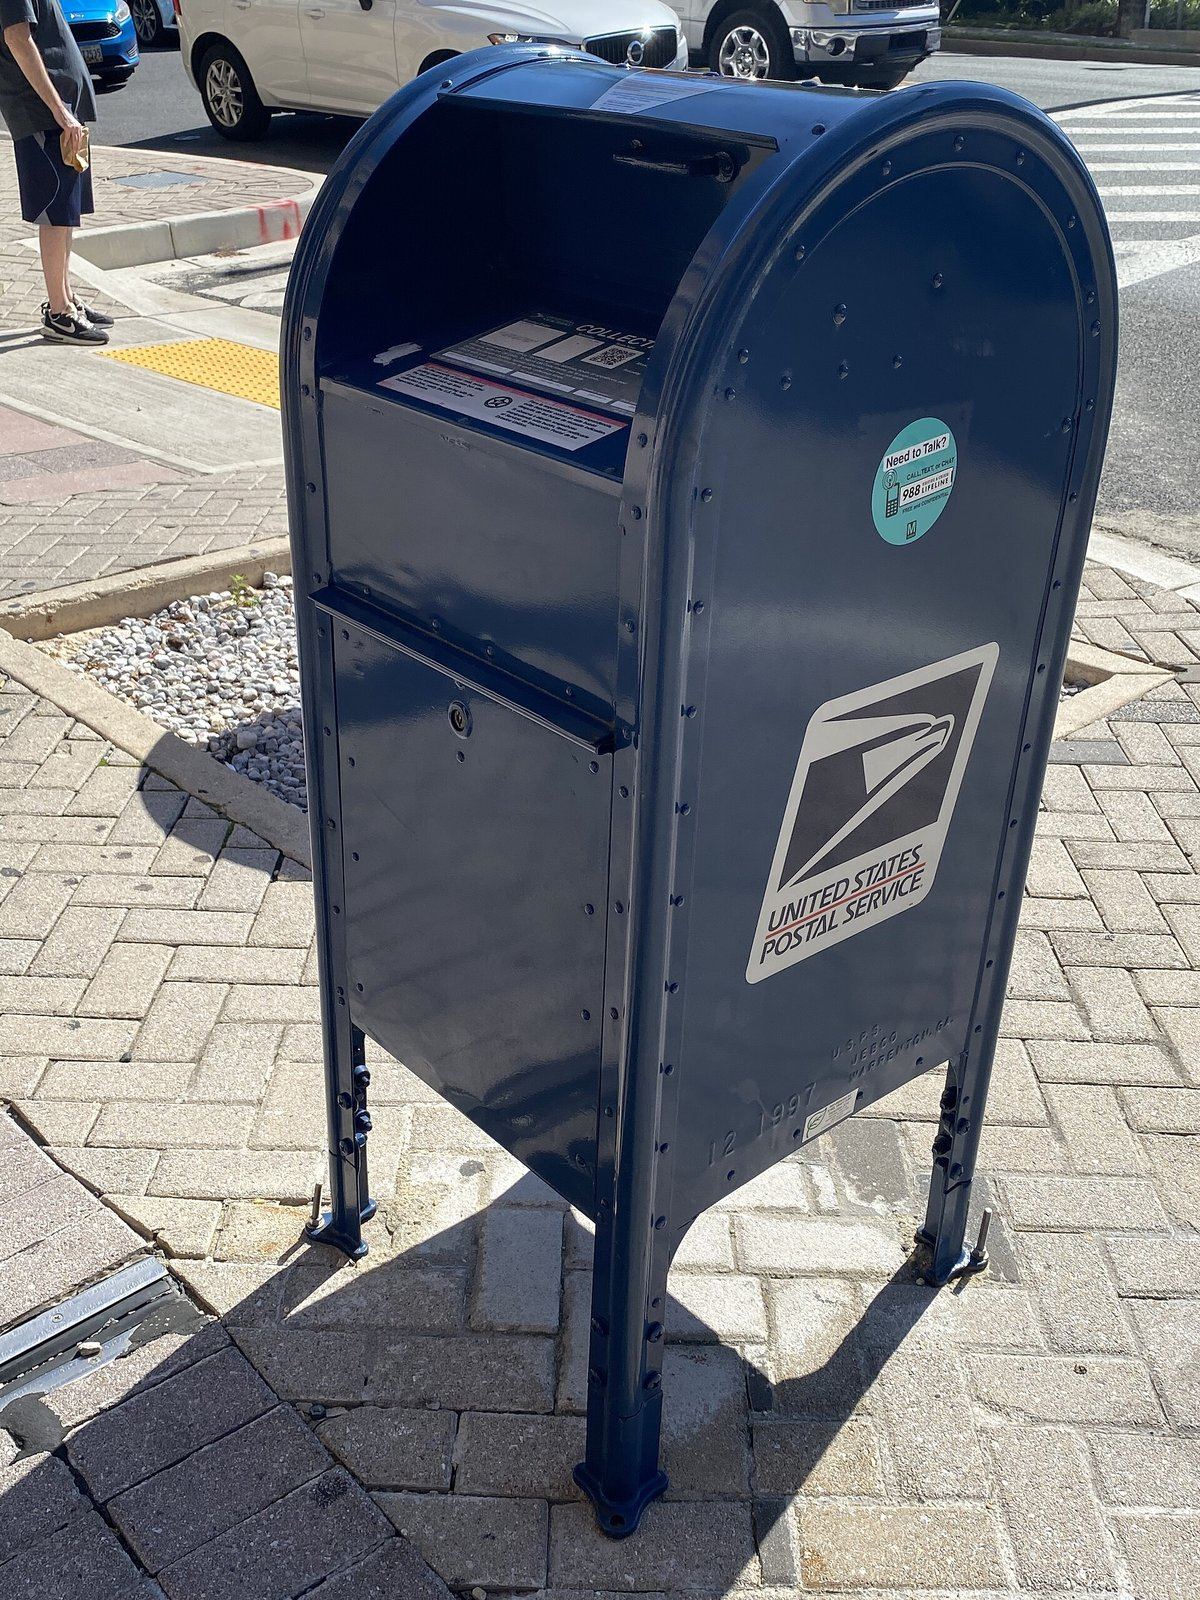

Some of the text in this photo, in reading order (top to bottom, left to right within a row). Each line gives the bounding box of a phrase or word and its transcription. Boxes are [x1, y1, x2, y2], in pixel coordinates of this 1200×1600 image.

[886, 436, 947, 469] Need to Talk?
[941, 456, 955, 467] CHAT
[902, 484, 921, 502] 988
[921, 477, 949, 494] LIFELINE
[760, 868, 925, 964] POSTAL SERVICE
[768, 844, 923, 931] UNITED STATES
[708, 1130, 737, 1168] 12
[757, 1081, 816, 1137] 1997
